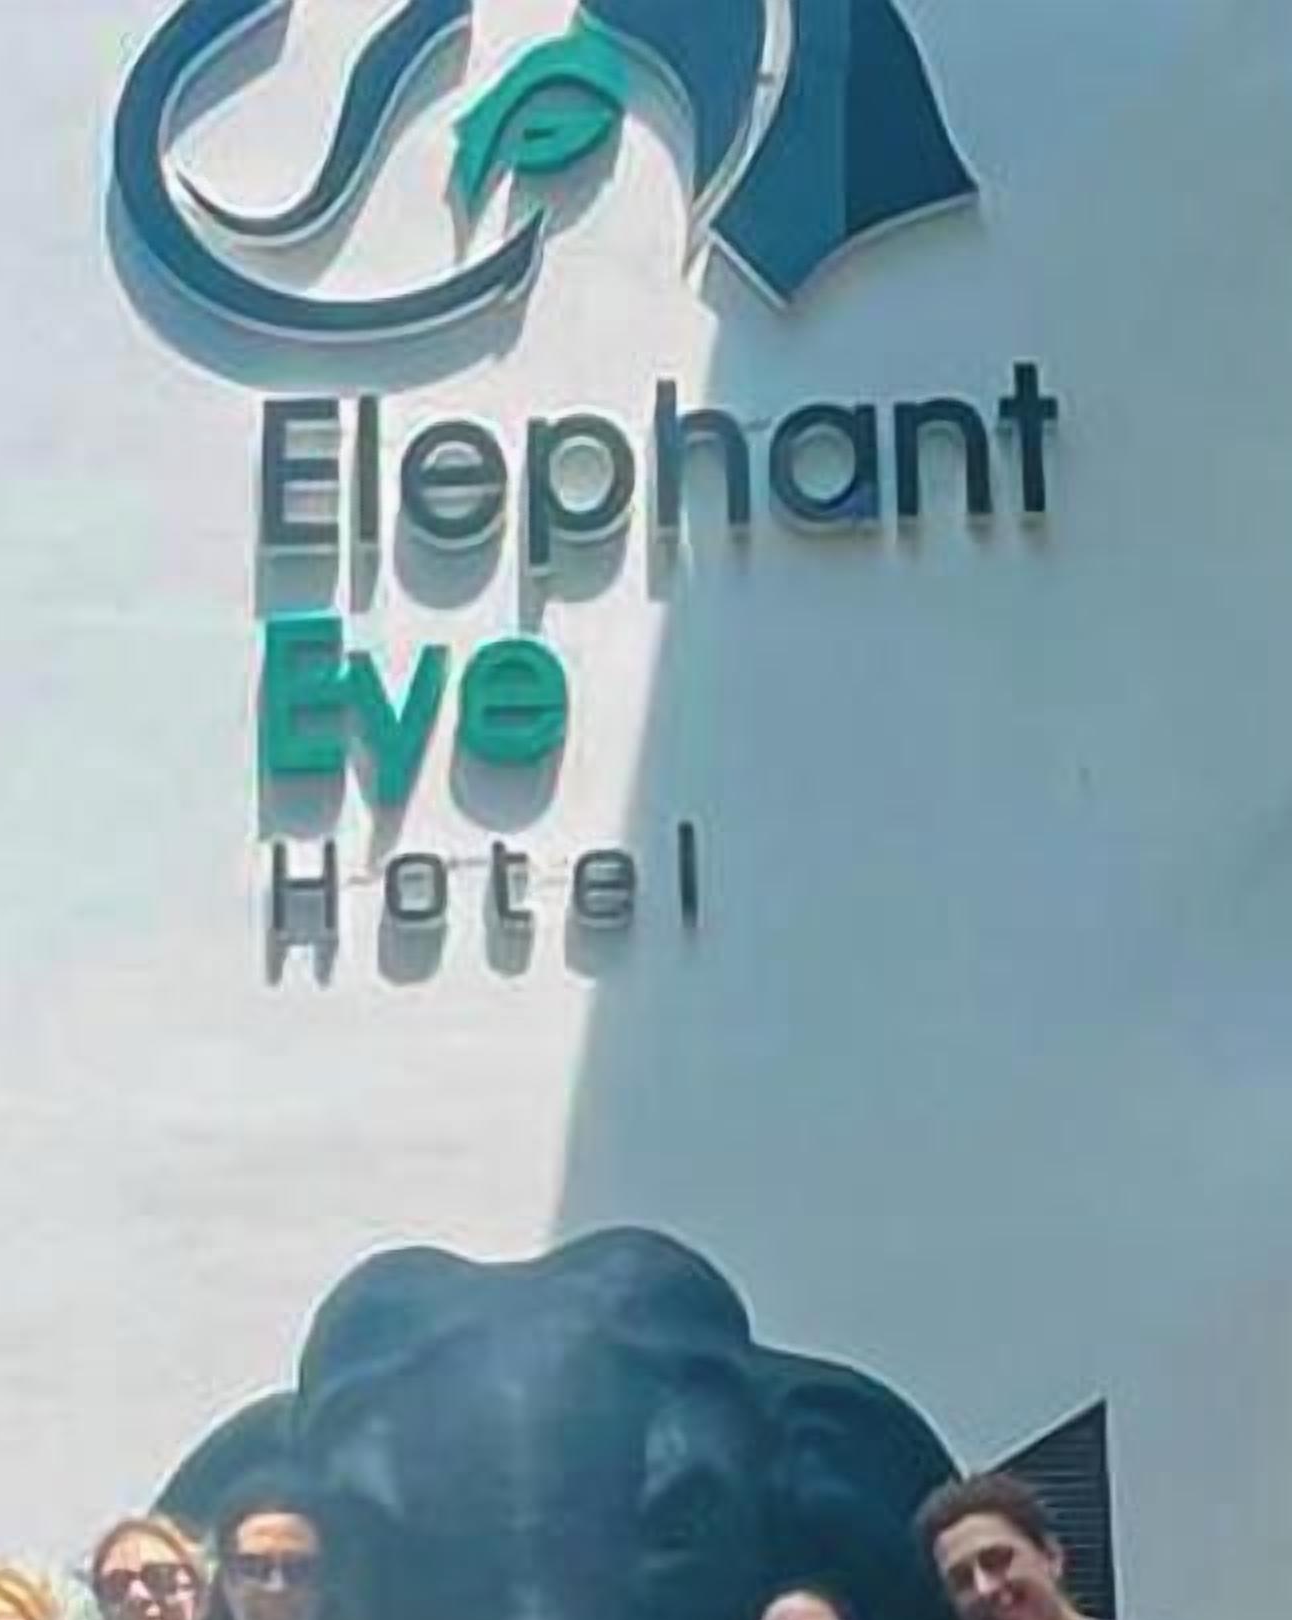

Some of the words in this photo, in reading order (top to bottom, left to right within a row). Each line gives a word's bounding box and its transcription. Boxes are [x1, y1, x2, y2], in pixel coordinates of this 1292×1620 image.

[261, 361, 1060, 567] Elephant
[262, 613, 570, 804] Eye
[271, 821, 698, 929] Hotel
